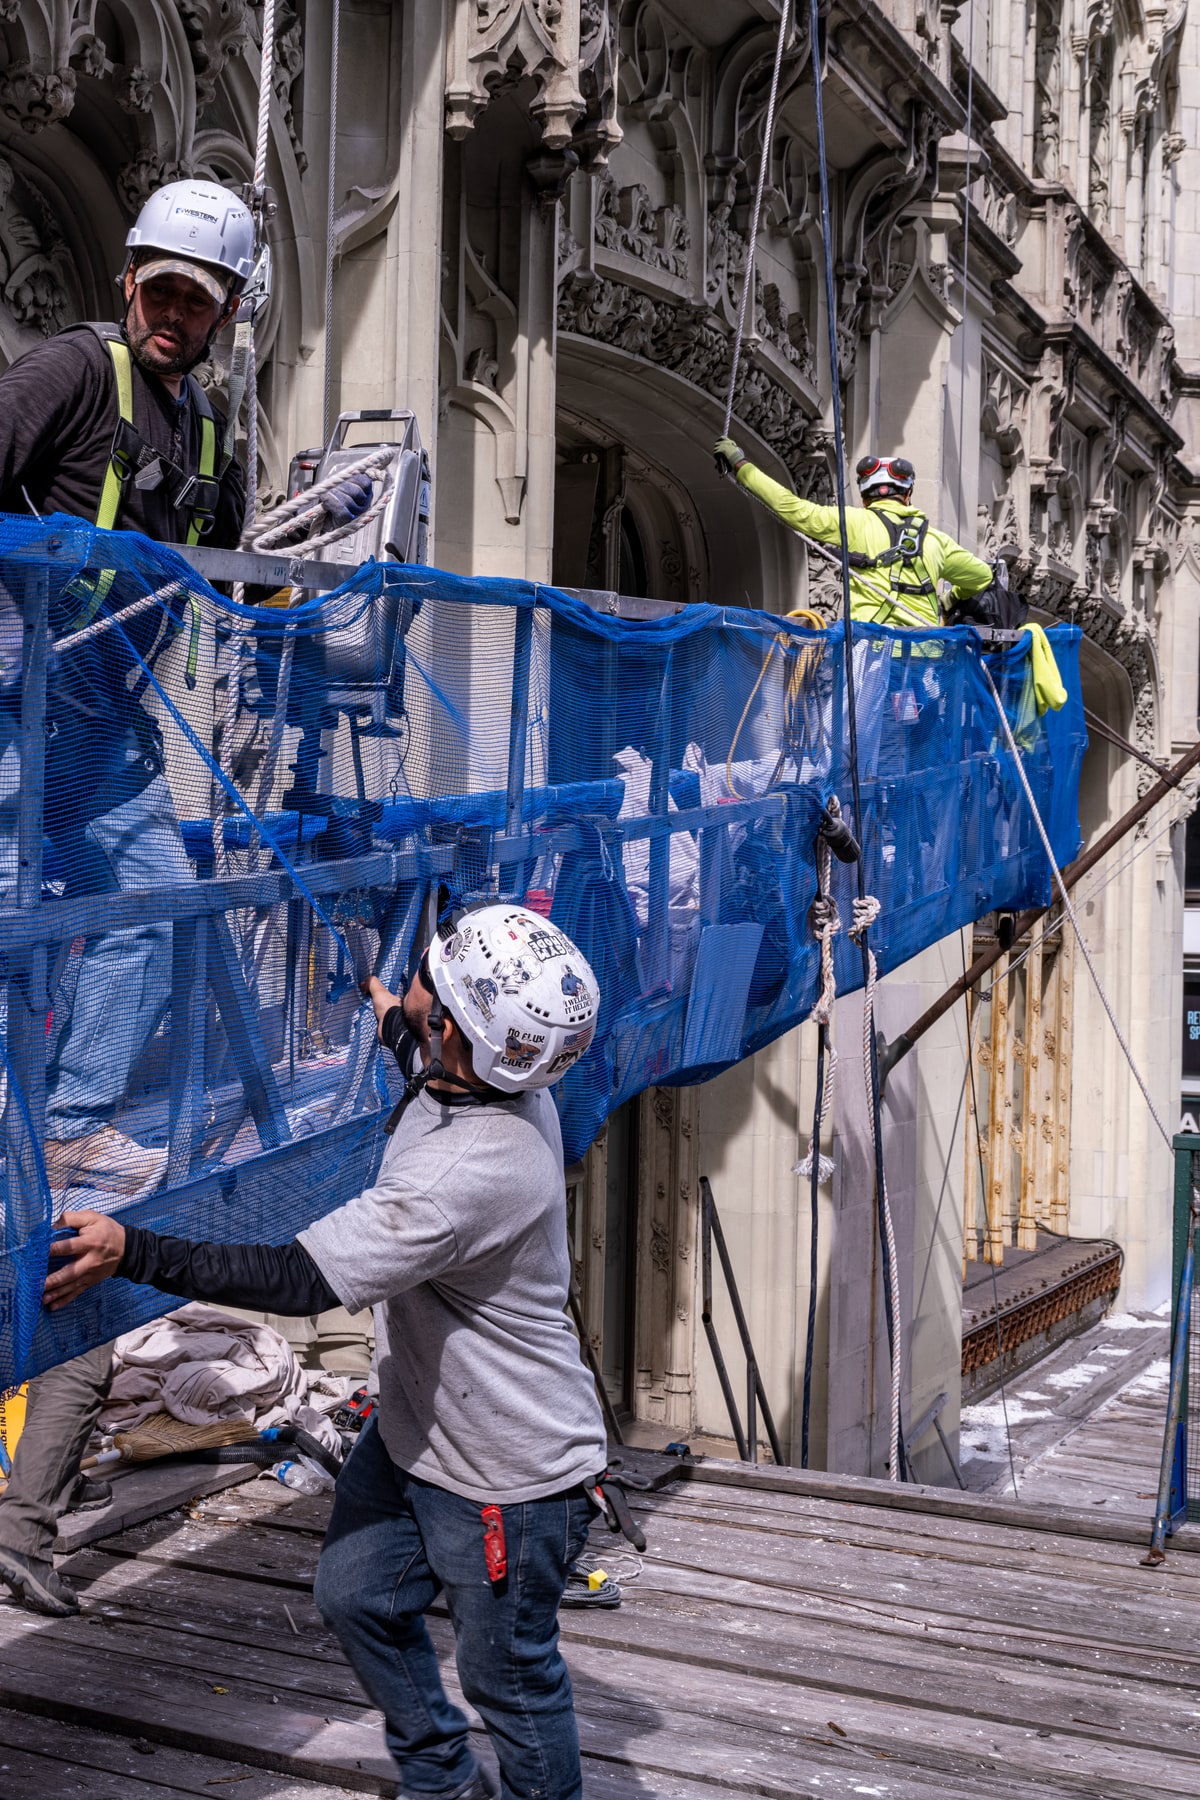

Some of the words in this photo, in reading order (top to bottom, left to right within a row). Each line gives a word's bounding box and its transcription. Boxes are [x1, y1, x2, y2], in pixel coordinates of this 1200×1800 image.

[184, 209, 218, 222] WESTERN
[508, 1027, 520, 1038] NO
[521, 1032, 545, 1044] FLUX
[501, 1056, 532, 1069] GIVEN
[0, 1416, 7, 1427] IN
